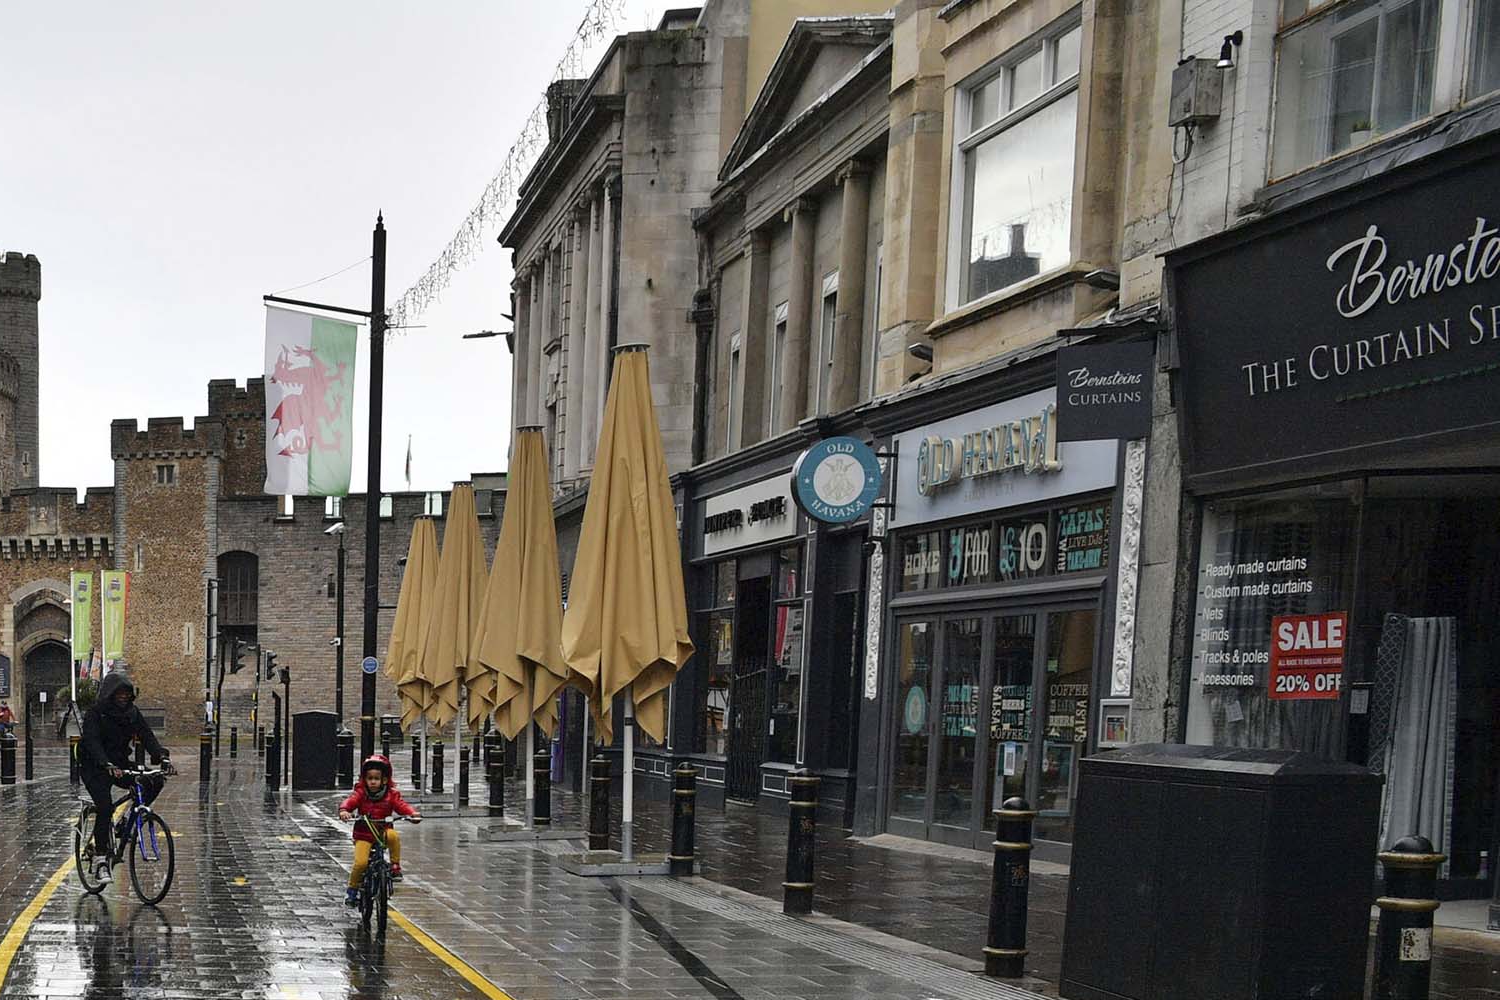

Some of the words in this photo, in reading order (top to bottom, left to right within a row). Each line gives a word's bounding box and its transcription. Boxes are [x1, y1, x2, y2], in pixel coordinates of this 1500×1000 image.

[1242, 358, 1298, 396] THE
[1308, 318, 1451, 380] CURTAIN
[1067, 367, 1142, 388] Bernsteins
[1068, 391, 1141, 405] CURTAINS
[827, 443, 854, 453] OLD
[917, 436, 963, 496] OLD
[961, 402, 1063, 479] HAVANA
[811, 500, 865, 517] HAVANA
[1060, 508, 1104, 537] TAPAS
[1068, 536, 1087, 548] LIVE
[904, 550, 940, 576] HOME
[963, 530, 990, 579] FOR
[1057, 537, 1068, 571] RUM
[1236, 559, 1264, 575] made
[1266, 556, 1307, 572] curtains
[1242, 580, 1270, 596] made
[1272, 578, 1313, 595] curtains
[1278, 618, 1342, 651] SALE
[1232, 649, 1240, 663] &
[1241, 649, 1269, 666] poles
[1050, 684, 1089, 696] COFFEE
[1275, 674, 1310, 692] 20%
[1314, 673, 1342, 691] OFF
[990, 685, 1003, 726] SALSA
[1074, 700, 1088, 742] SALSA
[990, 727, 1024, 739] COFFEE
